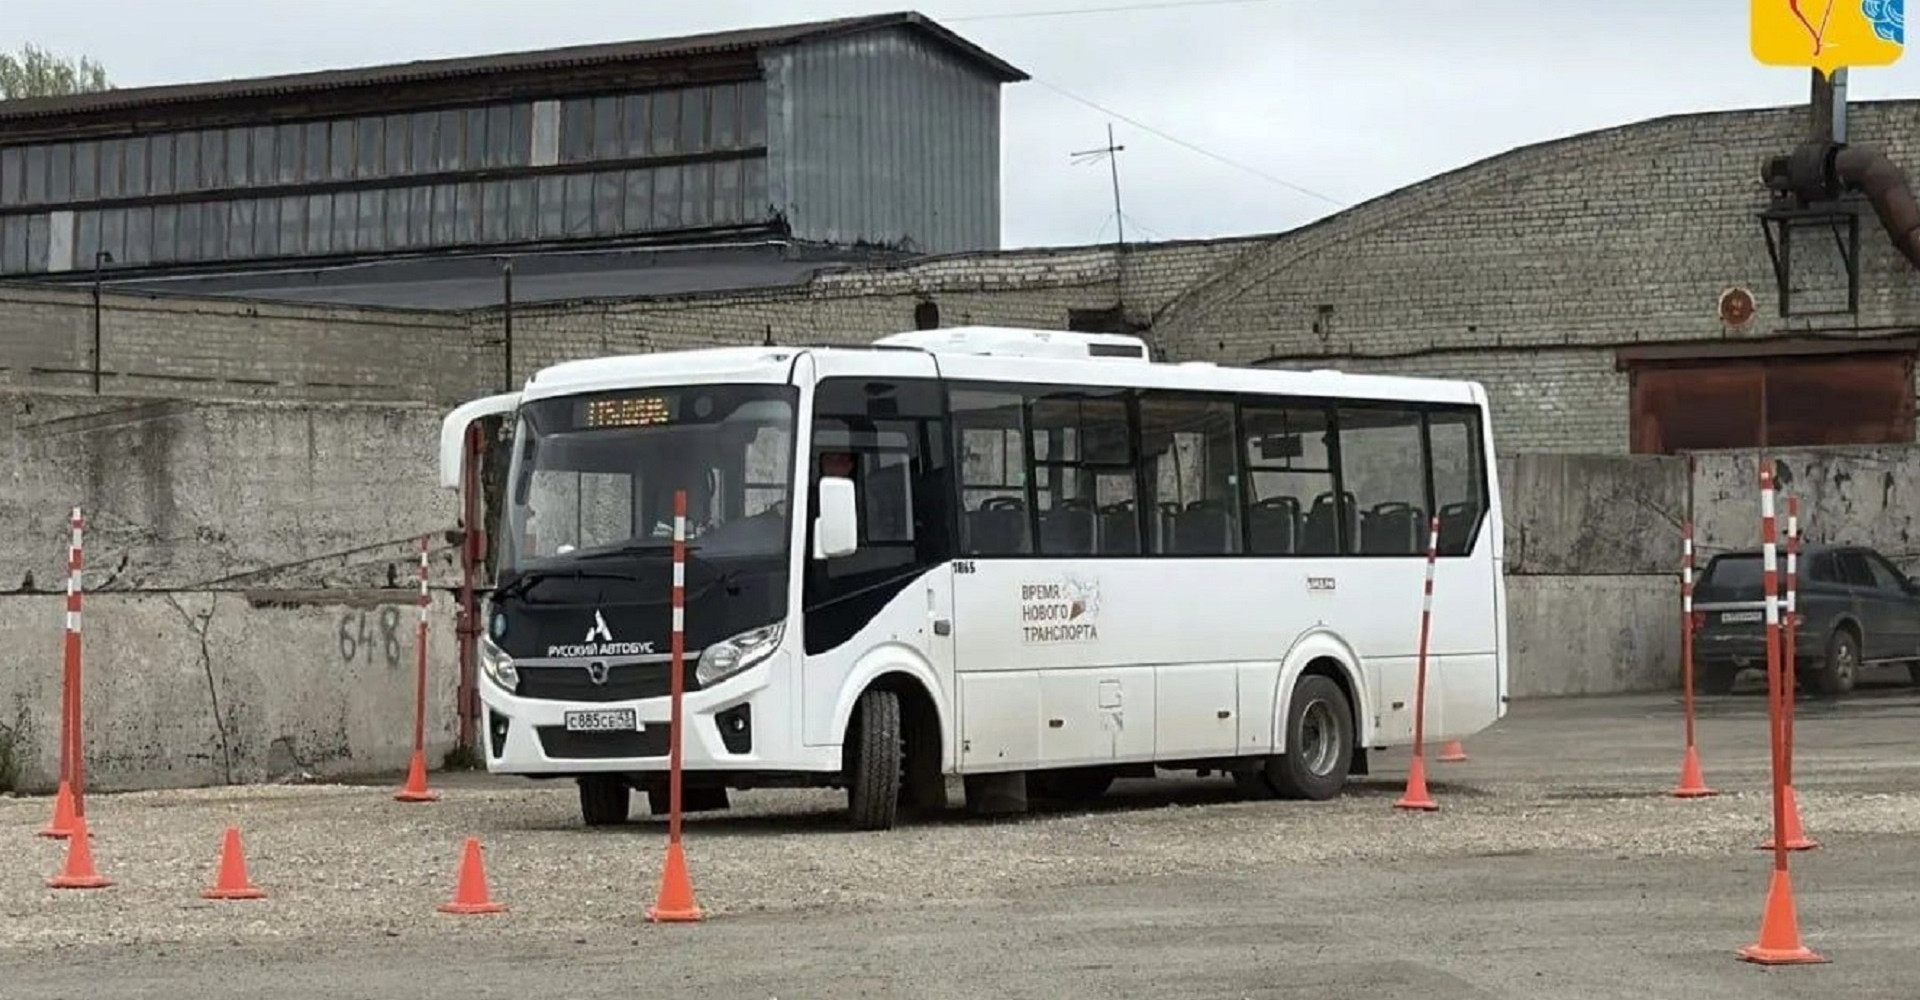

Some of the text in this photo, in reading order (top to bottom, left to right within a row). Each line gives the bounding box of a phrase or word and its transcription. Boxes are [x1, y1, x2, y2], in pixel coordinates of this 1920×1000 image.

[1022, 584, 1060, 600] ВРЕМЯ
[1022, 604, 1069, 621] НОВОГО
[339, 606, 400, 667] 648
[1023, 625, 1098, 642] ТРАНСПОРТА
[548, 641, 655, 657] РУССКИЙ АВТОБУС
